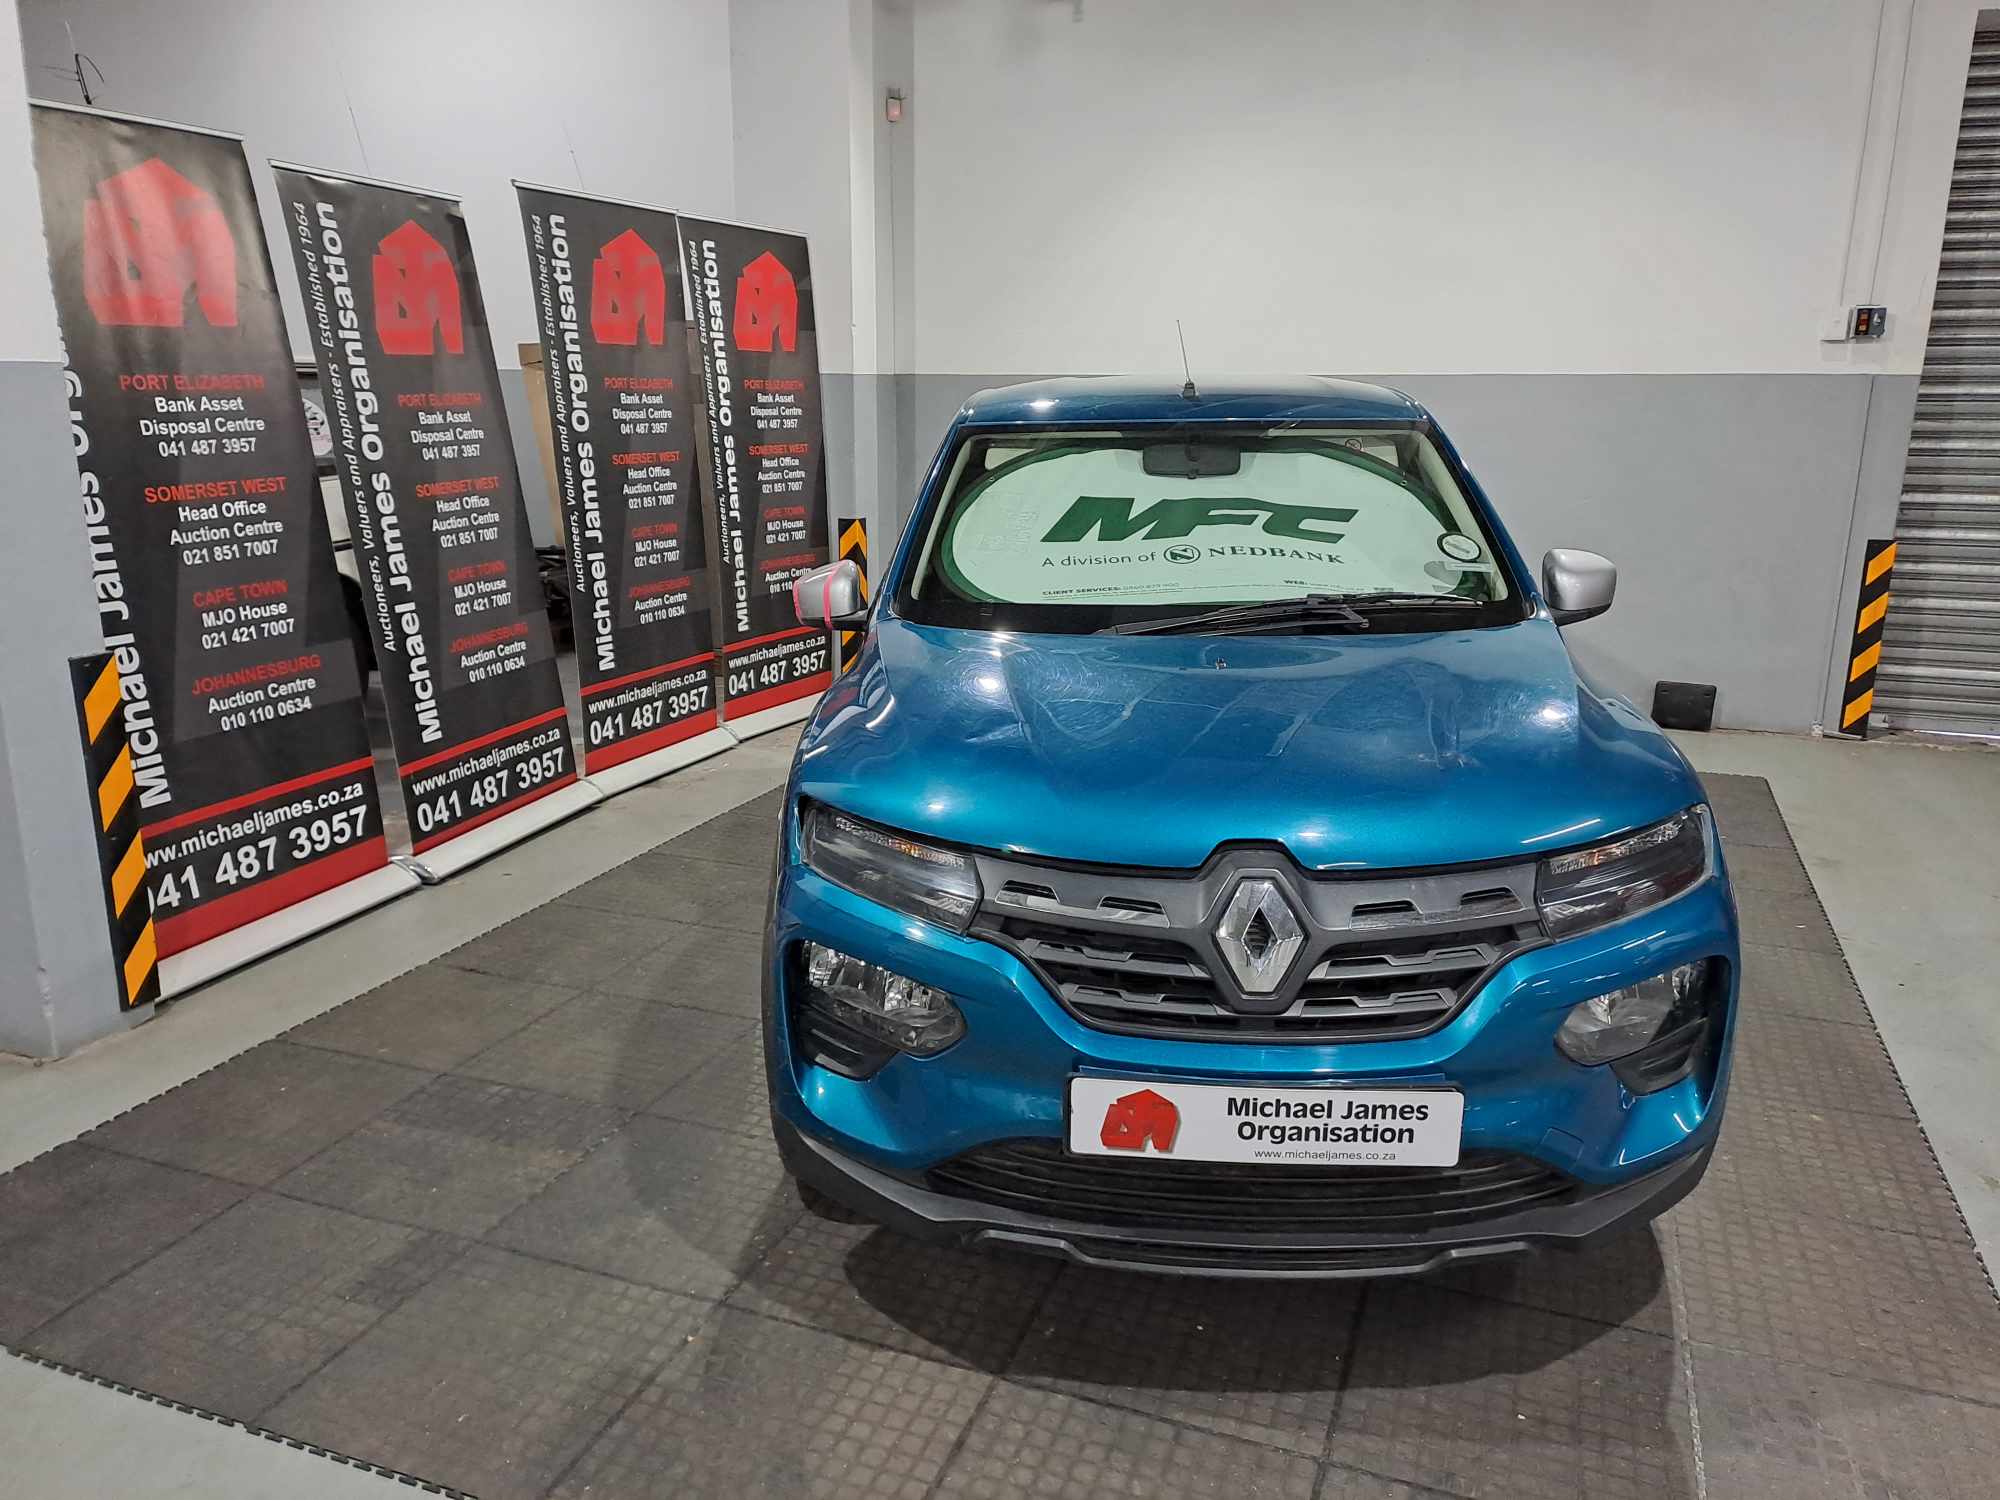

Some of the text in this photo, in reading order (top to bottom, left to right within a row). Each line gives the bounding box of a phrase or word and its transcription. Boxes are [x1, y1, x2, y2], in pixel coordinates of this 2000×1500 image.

[316, 202, 384, 461] Organisation
[119, 373, 265, 391] PORT ELIZABETH
[154, 396, 244, 412] Bank Asset
[530, 214, 586, 593] Auctioneers, Valuers and Appraisers Established 1964
[620, 392, 664, 405] Bank Asset
[780, 406, 803, 416] Centre
[140, 416, 265, 438] Disposal Centre
[292, 201, 397, 651] Auctioneers, Valuers and Appraisers Established 1964
[418, 411, 472, 425] Bank Asset
[612, 408, 673, 422] Disposal Centre
[782, 418, 798, 429] 3957
[410, 428, 484, 445] Disposal Centre
[621, 423, 634, 435] 041
[651, 422, 668, 434] 3957
[702, 240, 750, 633] Michael James Organisation
[159, 437, 256, 458] 041 487 3957
[422, 444, 481, 460] 041 487 3957
[549, 214, 616, 672] Michael James Organisation
[474, 475, 499, 490] WEST
[627, 466, 671, 480] Head Office
[758, 470, 782, 481] Auction
[144, 476, 288, 504] SOMERSET WEST
[623, 481, 678, 495] Auction Centre
[178, 500, 266, 522] Head Office
[436, 495, 490, 514] Head Office
[629, 494, 675, 509] 021 851 7007
[170, 518, 283, 545] Auction Centre
[371, 472, 412, 592] James
[432, 512, 500, 533] Auction Centre
[1039, 495, 1359, 544] MFC
[440, 527, 498, 548] 021 851 7007
[653, 538, 677, 550] House
[183, 539, 279, 565] 021 851 7007
[634, 550, 680, 569] 021 421 7007
[1041, 545, 1345, 567] A division of NEDBANK
[193, 580, 288, 608] CAPE TOWN
[453, 579, 507, 599] MJO House
[634, 591, 688, 612] Auction Centre
[1076, 586, 1121, 594] SERVICES:
[202, 601, 287, 628] MJO House
[454, 592, 512, 617] 021 421 7007
[640, 605, 685, 625] 010 110 0634
[202, 618, 294, 650] 021 421 7007
[460, 640, 527, 669] Auction Centre
[728, 635, 826, 669] www.michaeljames.co.za
[191, 655, 321, 695] JOHANNESBURG
[394, 602, 443, 744] Michael
[469, 656, 526, 683] 010 110 0634
[728, 649, 826, 696] 041 487 3957
[208, 677, 316, 713] Auction Centre
[588, 669, 708, 714] www.michaeljames.co.za
[105, 632, 172, 808] Michael
[221, 696, 311, 731] 010 110 0634
[590, 685, 710, 746] 041 487 3957
[412, 727, 561, 796] www.michaeljames.co.za
[417, 747, 564, 833] 041 487 3957
[143, 780, 364, 869] ww.michaeljames.co.za
[147, 803, 368, 915] 41 487 3957
[1226, 1096, 1430, 1122] Michael James
[1236, 1120, 1415, 1145] Organisation
[1254, 1148, 1397, 1163] www.michaeljames.co.za
